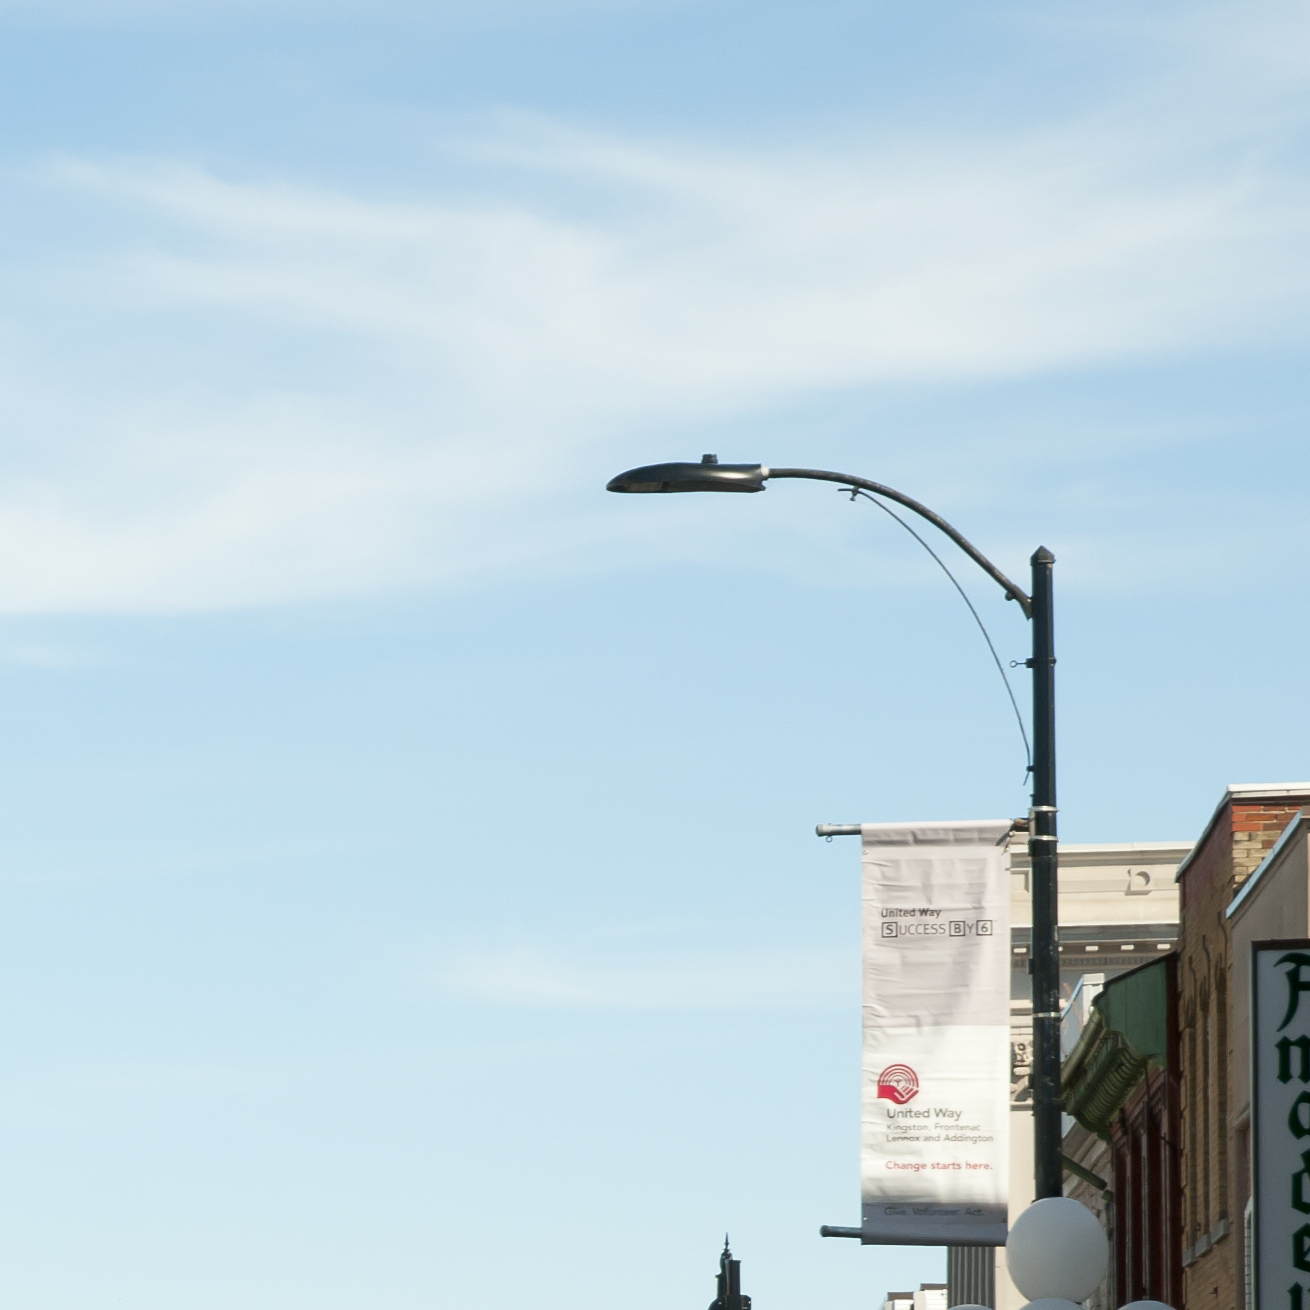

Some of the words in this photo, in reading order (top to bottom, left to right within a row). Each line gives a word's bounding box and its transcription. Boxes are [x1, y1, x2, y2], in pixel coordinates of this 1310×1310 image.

[881, 908, 916, 918] United
[919, 908, 942, 919] Way
[883, 922, 947, 937] SUCCESS
[886, 1108, 931, 1119] United
[934, 1108, 962, 1121] Way
[886, 1123, 931, 1133] Kingston,
[934, 1123, 981, 1131] Frontenac
[886, 1134, 921, 1142] Lennox
[923, 1134, 941, 1142] and
[943, 1134, 994, 1144] Addington
[885, 1161, 927, 1172] Change
[931, 1162, 962, 1170] starts
[965, 1161, 993, 1170] here.
